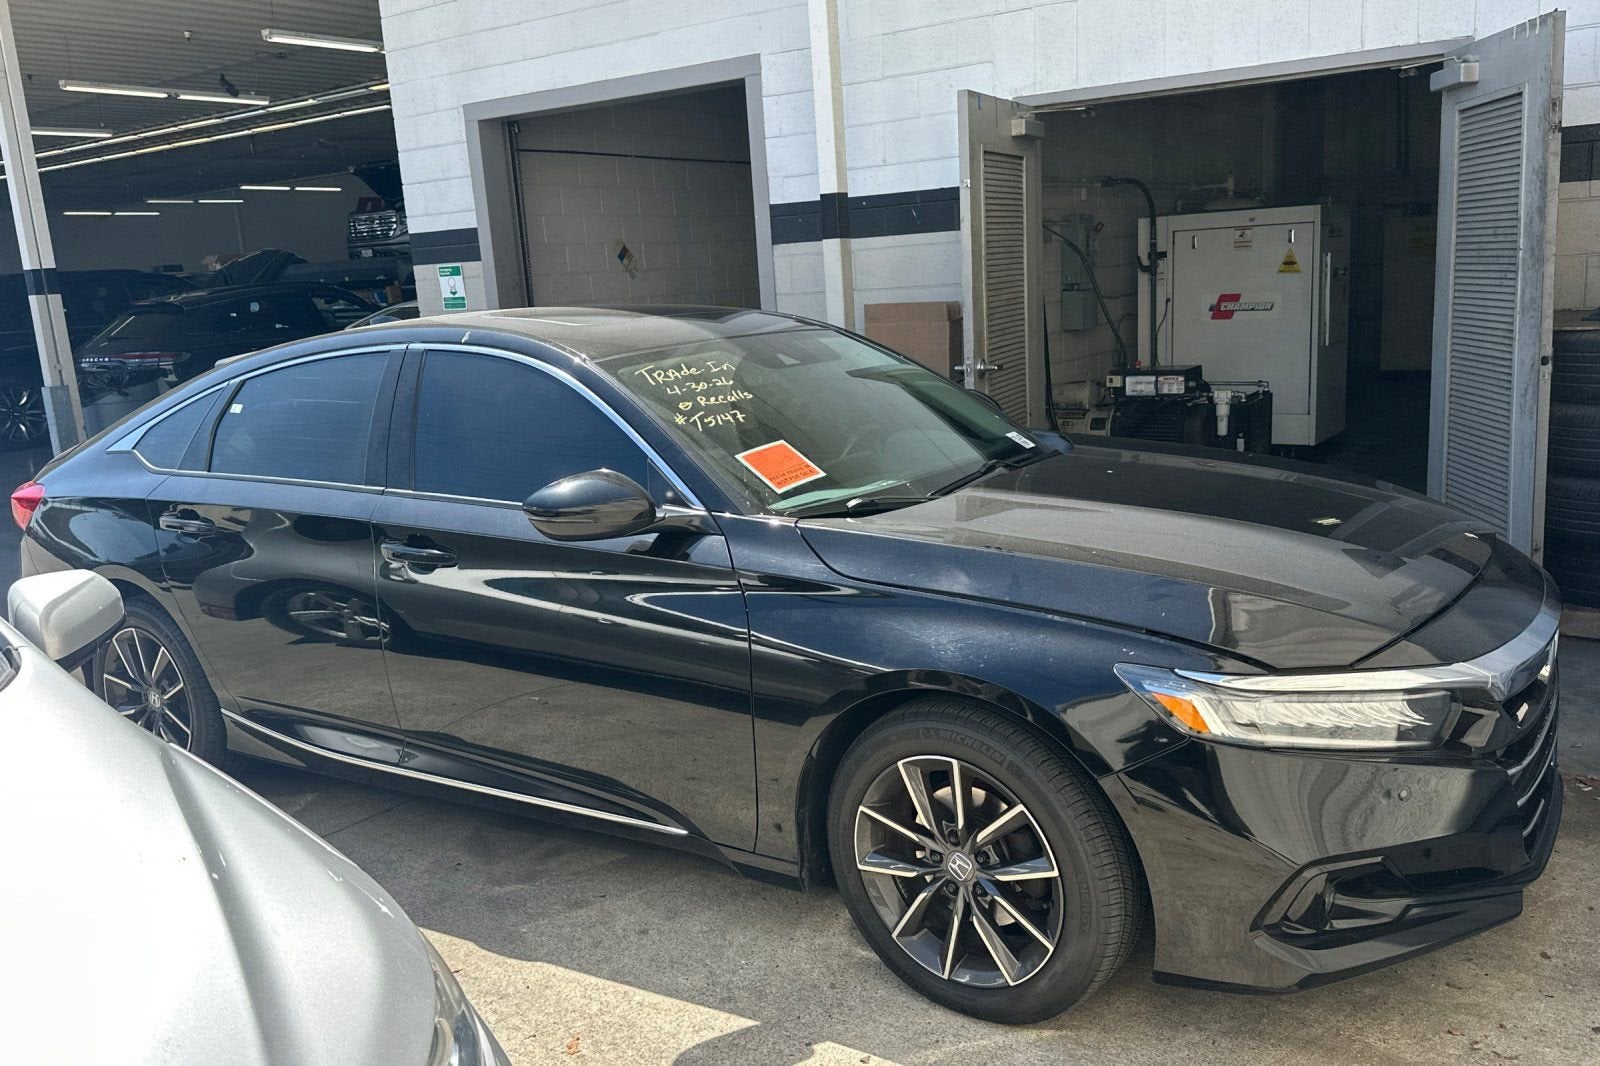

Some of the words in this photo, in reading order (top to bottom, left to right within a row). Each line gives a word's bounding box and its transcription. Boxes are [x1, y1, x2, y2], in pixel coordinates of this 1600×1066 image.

[1220, 302, 1272, 311] CHAMPION
[697, 390, 753, 407] Recalls
[938, 730, 1006, 765] MICHELIN
